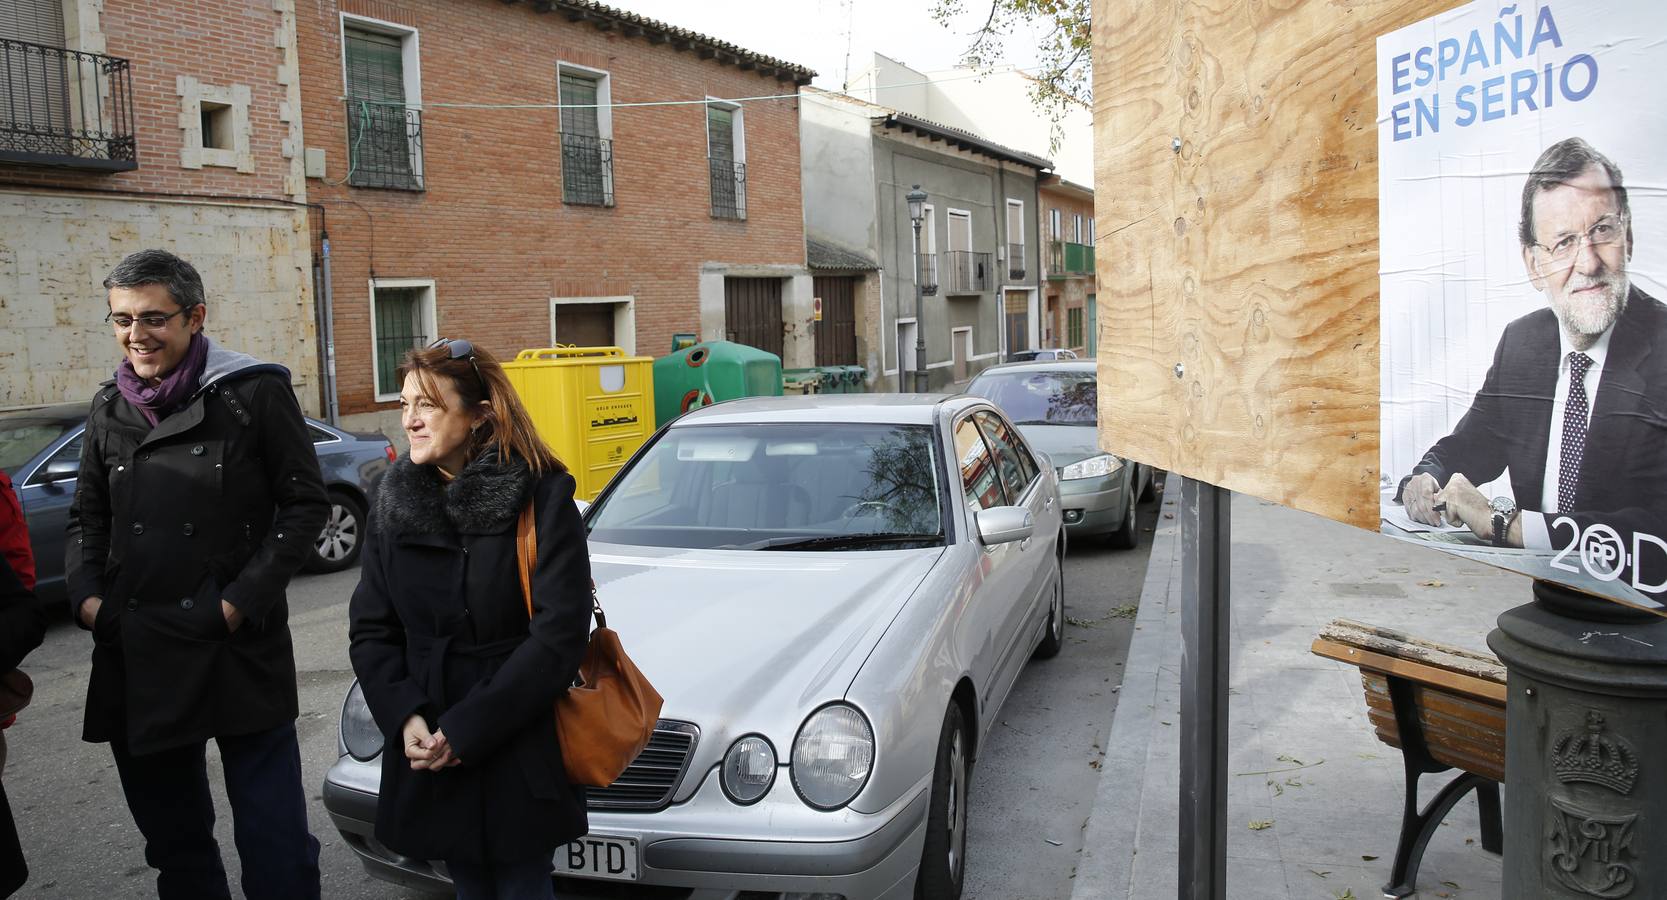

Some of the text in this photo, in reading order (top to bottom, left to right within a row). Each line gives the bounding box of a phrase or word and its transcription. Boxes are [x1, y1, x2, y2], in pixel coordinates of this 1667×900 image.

[1392, 3, 1563, 95] ESPAÑA
[1391, 53, 1599, 141] EN SERIO
[567, 839, 626, 874] BTD
